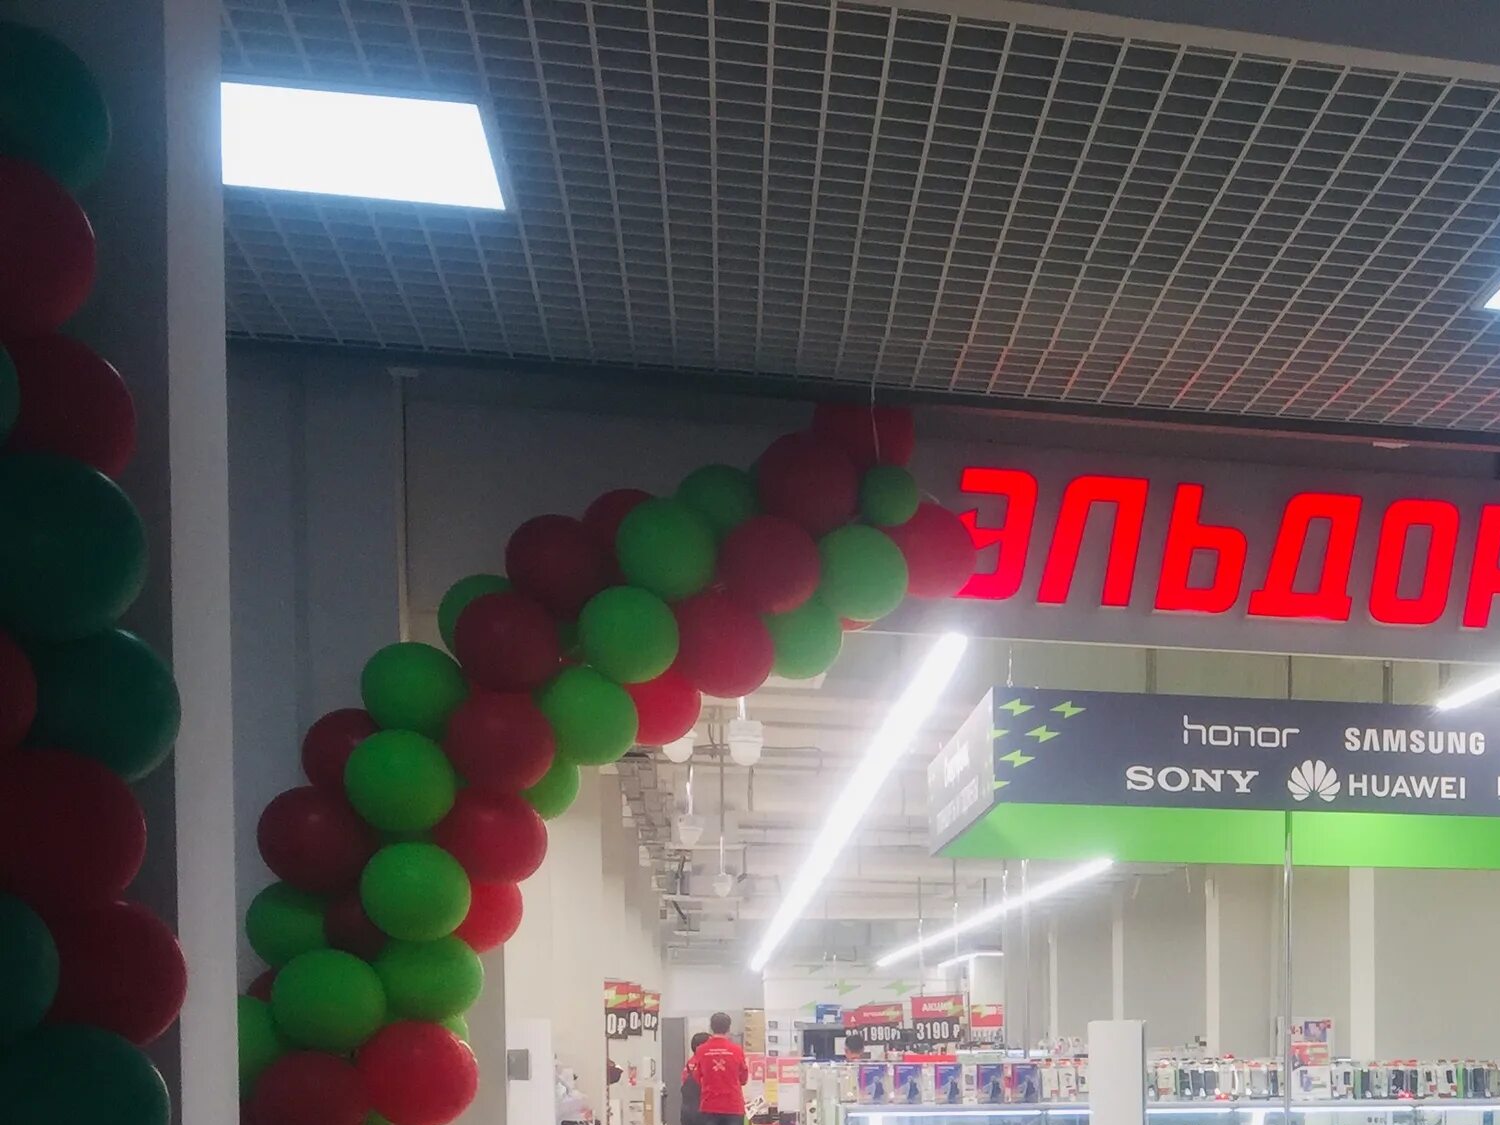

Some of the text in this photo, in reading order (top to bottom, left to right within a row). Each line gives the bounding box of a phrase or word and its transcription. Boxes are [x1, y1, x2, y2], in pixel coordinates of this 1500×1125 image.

[1344, 727, 1486, 755] SAMSUNG
[1125, 765, 1260, 793] SONY
[1349, 774, 1467, 799] HUAWEI
[917, 1022, 949, 1040] 3190
